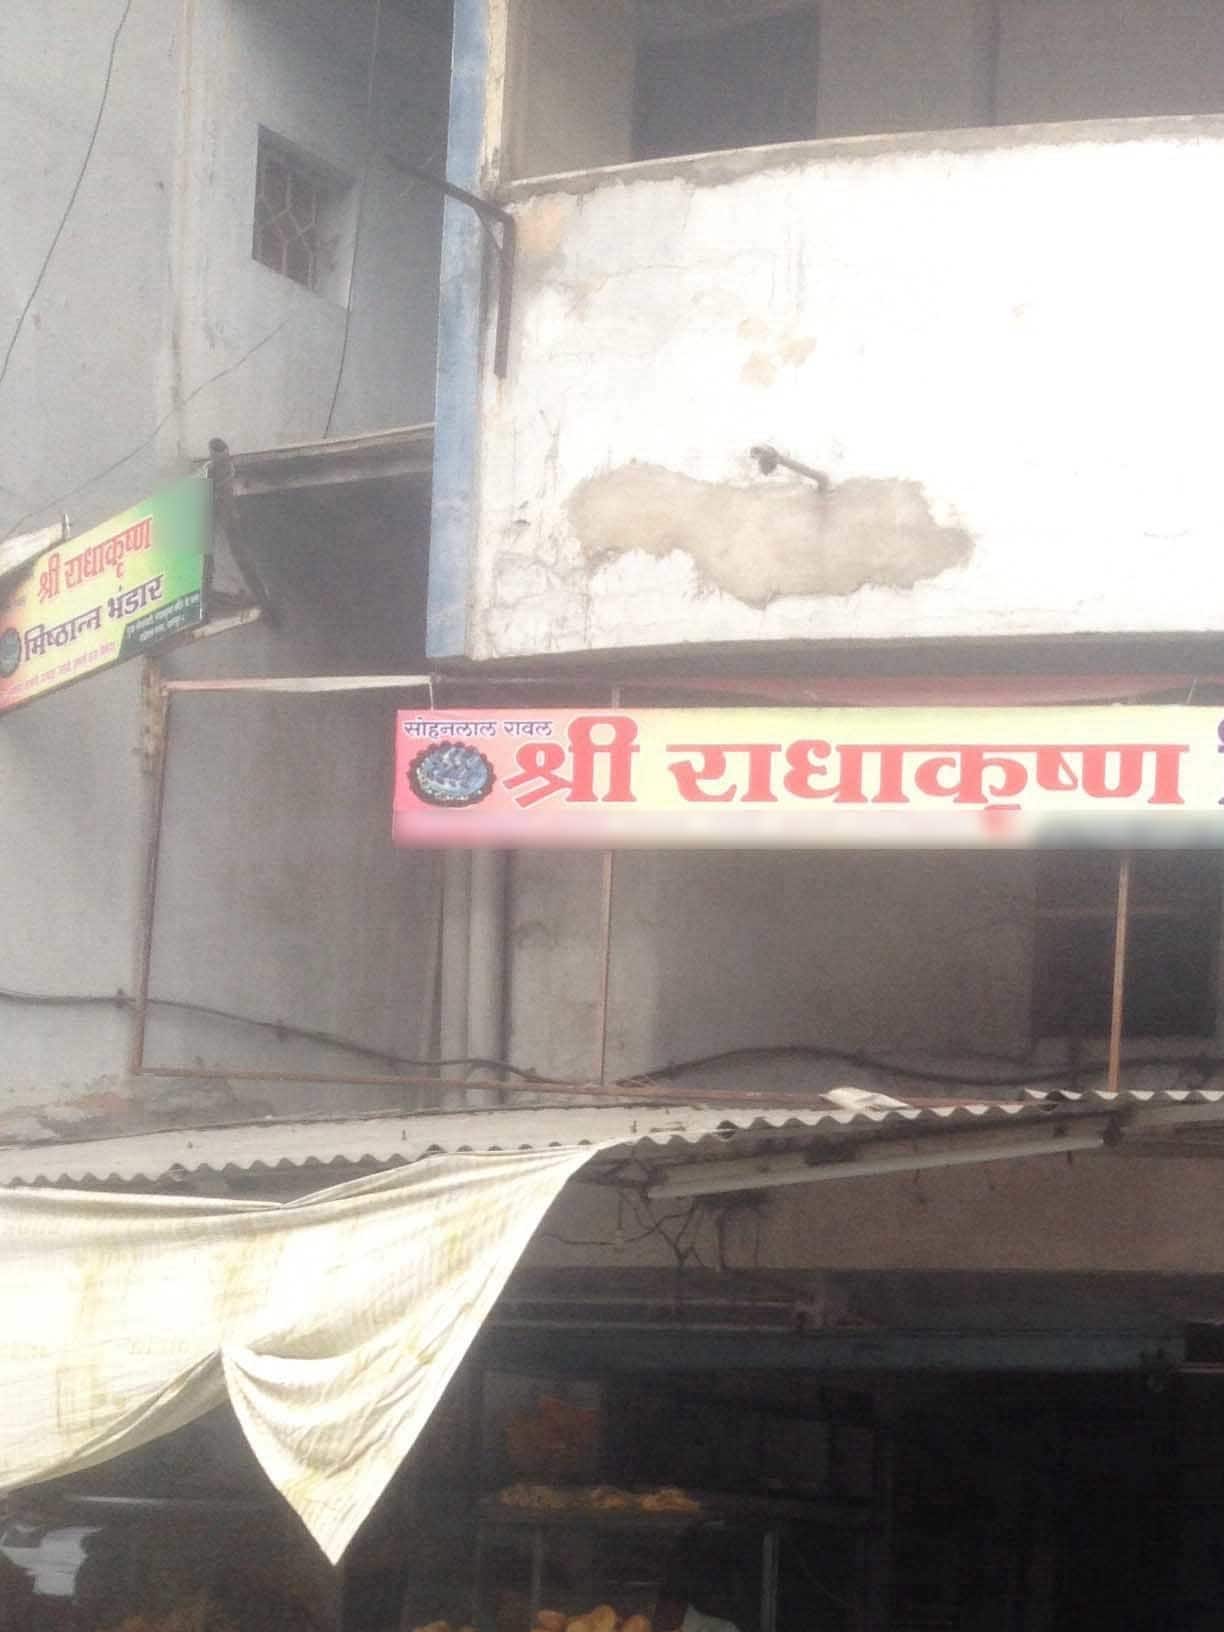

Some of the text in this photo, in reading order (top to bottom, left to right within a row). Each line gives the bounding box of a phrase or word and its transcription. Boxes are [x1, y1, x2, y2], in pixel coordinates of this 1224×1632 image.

[38, 552, 61, 604] श्री
[25, 605, 102, 661] मिष्ठान्न
[107, 573, 165, 619] भंडार
[404, 716, 553, 739] सोहनलाल रावल
[504, 715, 640, 809] श्री
